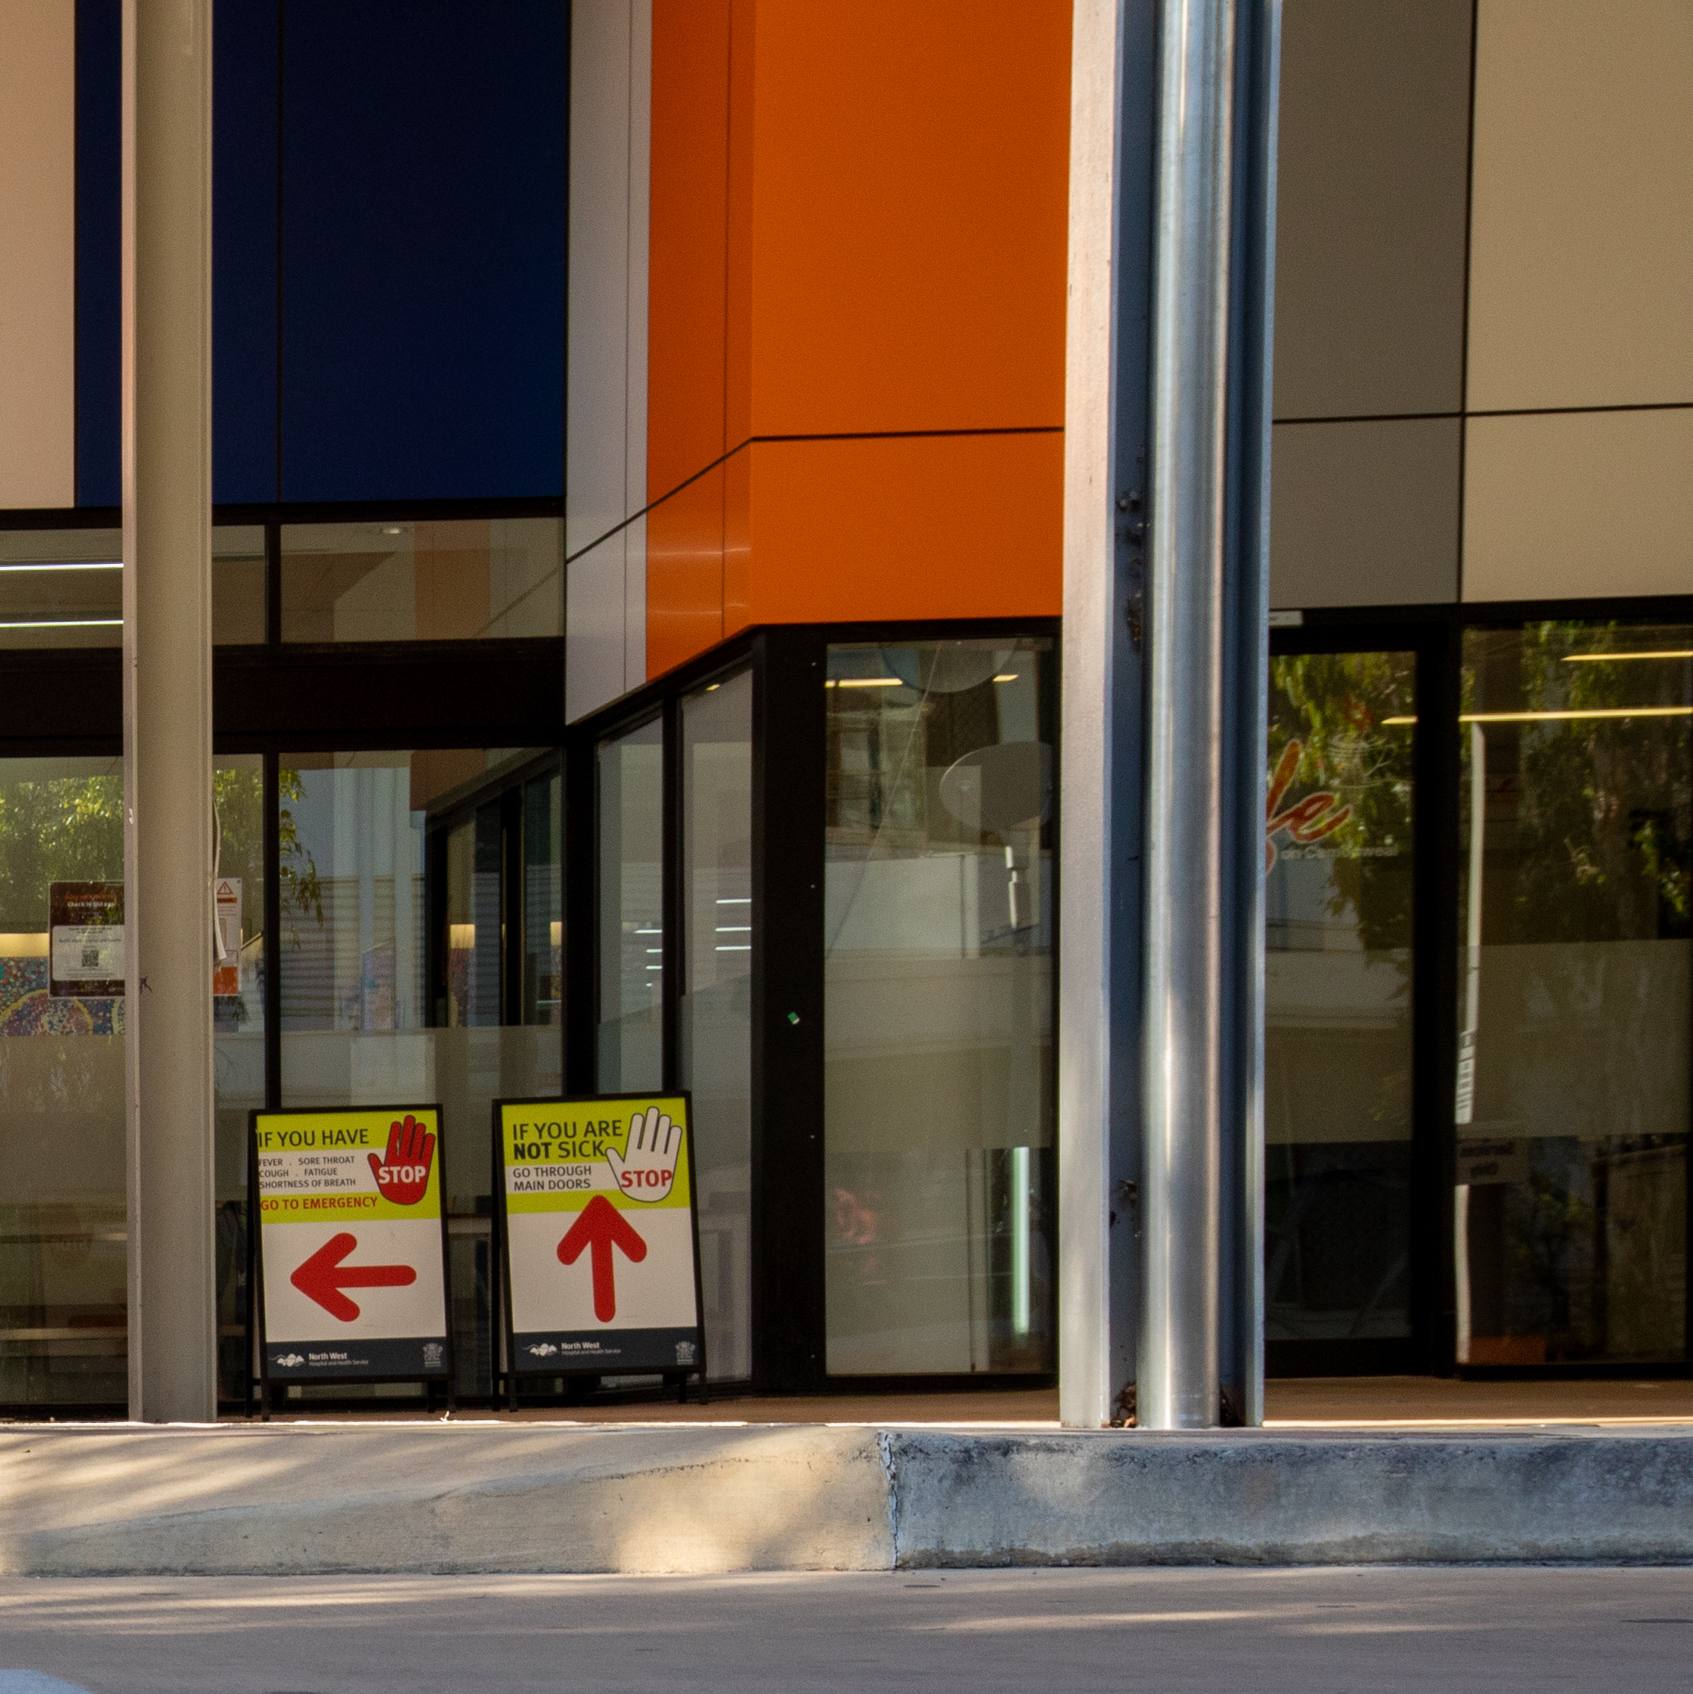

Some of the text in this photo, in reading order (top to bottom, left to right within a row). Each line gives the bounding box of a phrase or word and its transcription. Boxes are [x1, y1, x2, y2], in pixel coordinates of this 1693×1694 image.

[512, 1120, 623, 1140] IF YOU ARE
[258, 1129, 369, 1147] IF YOU HAVE
[514, 1140, 607, 1160] NOT SICK
[259, 1156, 355, 1167] FEVER SORE THROAT
[259, 1168, 338, 1178] COUGH FATIGUE
[378, 1165, 426, 1184] STOP
[513, 1165, 592, 1178] GO THROUGH
[260, 1178, 356, 1189] SHORTNESS OF BREATH
[514, 1179, 591, 1191] MAIN DOORS
[620, 1169, 673, 1188] STOP
[260, 1196, 378, 1210] GO TO EMERGENCY
[561, 1341, 600, 1350] North West
[308, 1352, 348, 1360] North West
